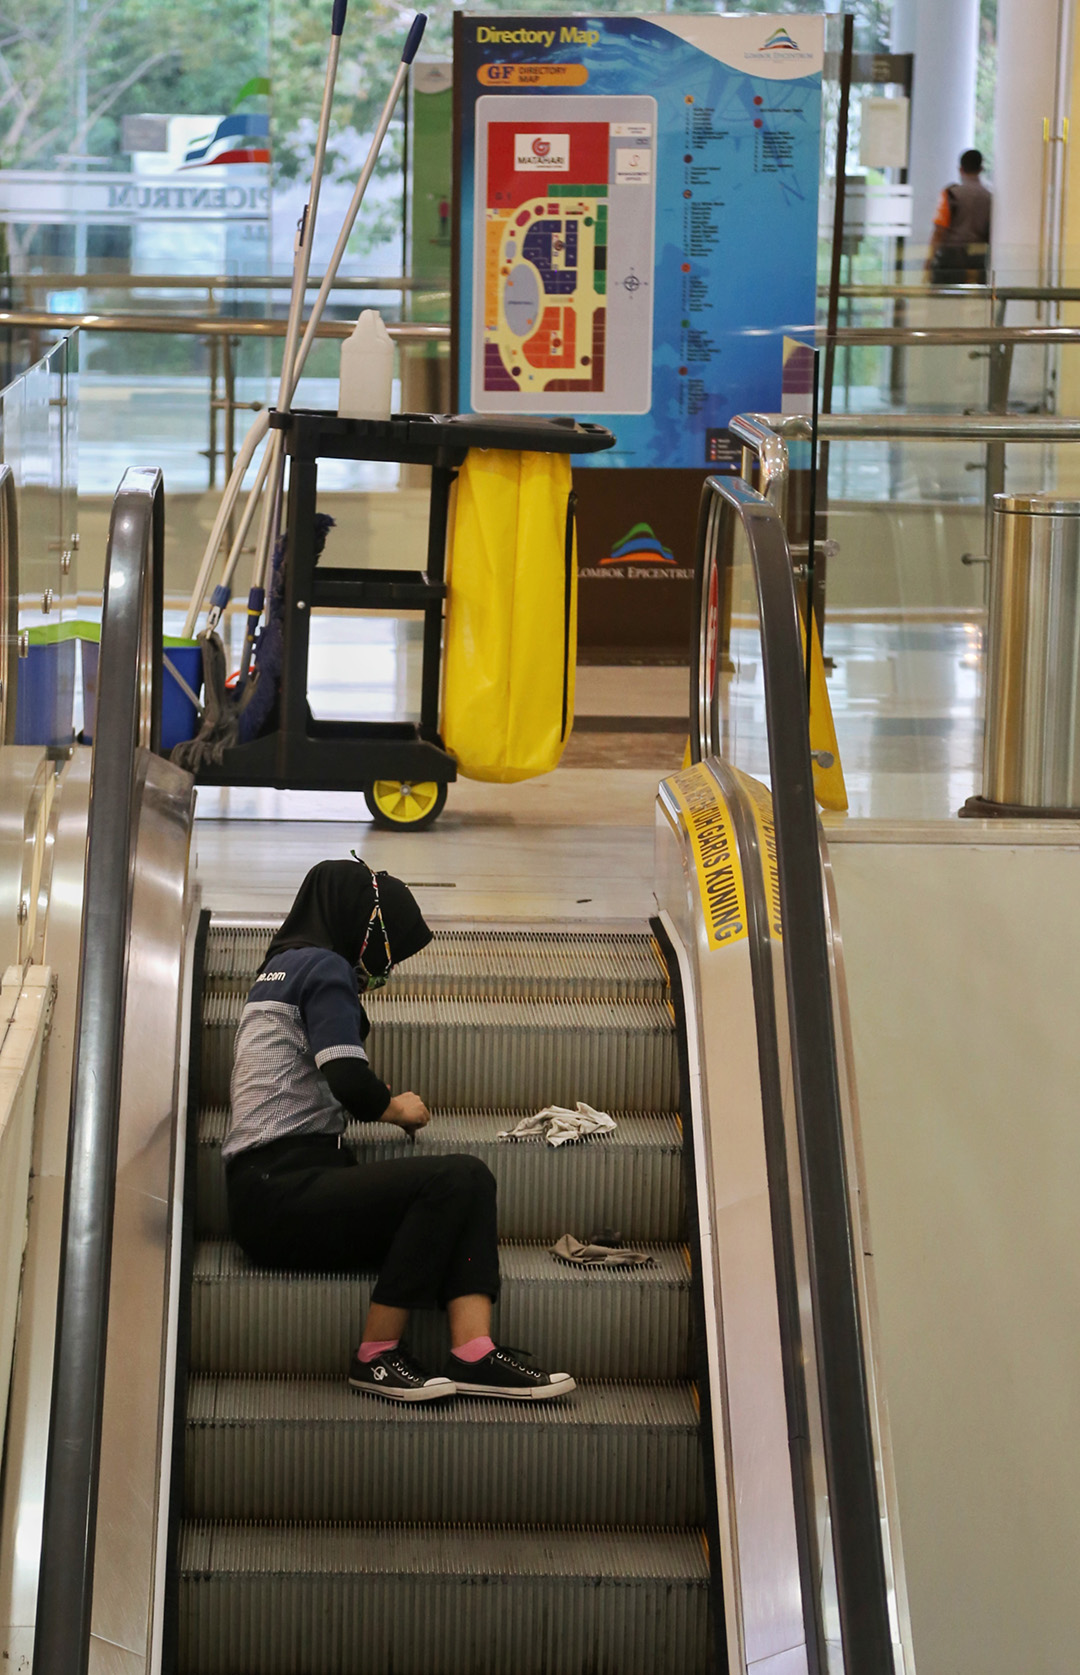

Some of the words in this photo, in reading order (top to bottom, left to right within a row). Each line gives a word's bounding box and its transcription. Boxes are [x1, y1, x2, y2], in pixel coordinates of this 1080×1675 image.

[476, 26, 556, 48] Directory
[560, 26, 600, 47] Map
[487, 66, 514, 80] GF
[518, 67, 566, 75] DIRECTORY
[518, 157, 565, 165] MATAHARI
[627, 567, 695, 579] EPICENTRU
[697, 823, 729, 869] GARIS
[704, 864, 744, 942] KUNING
